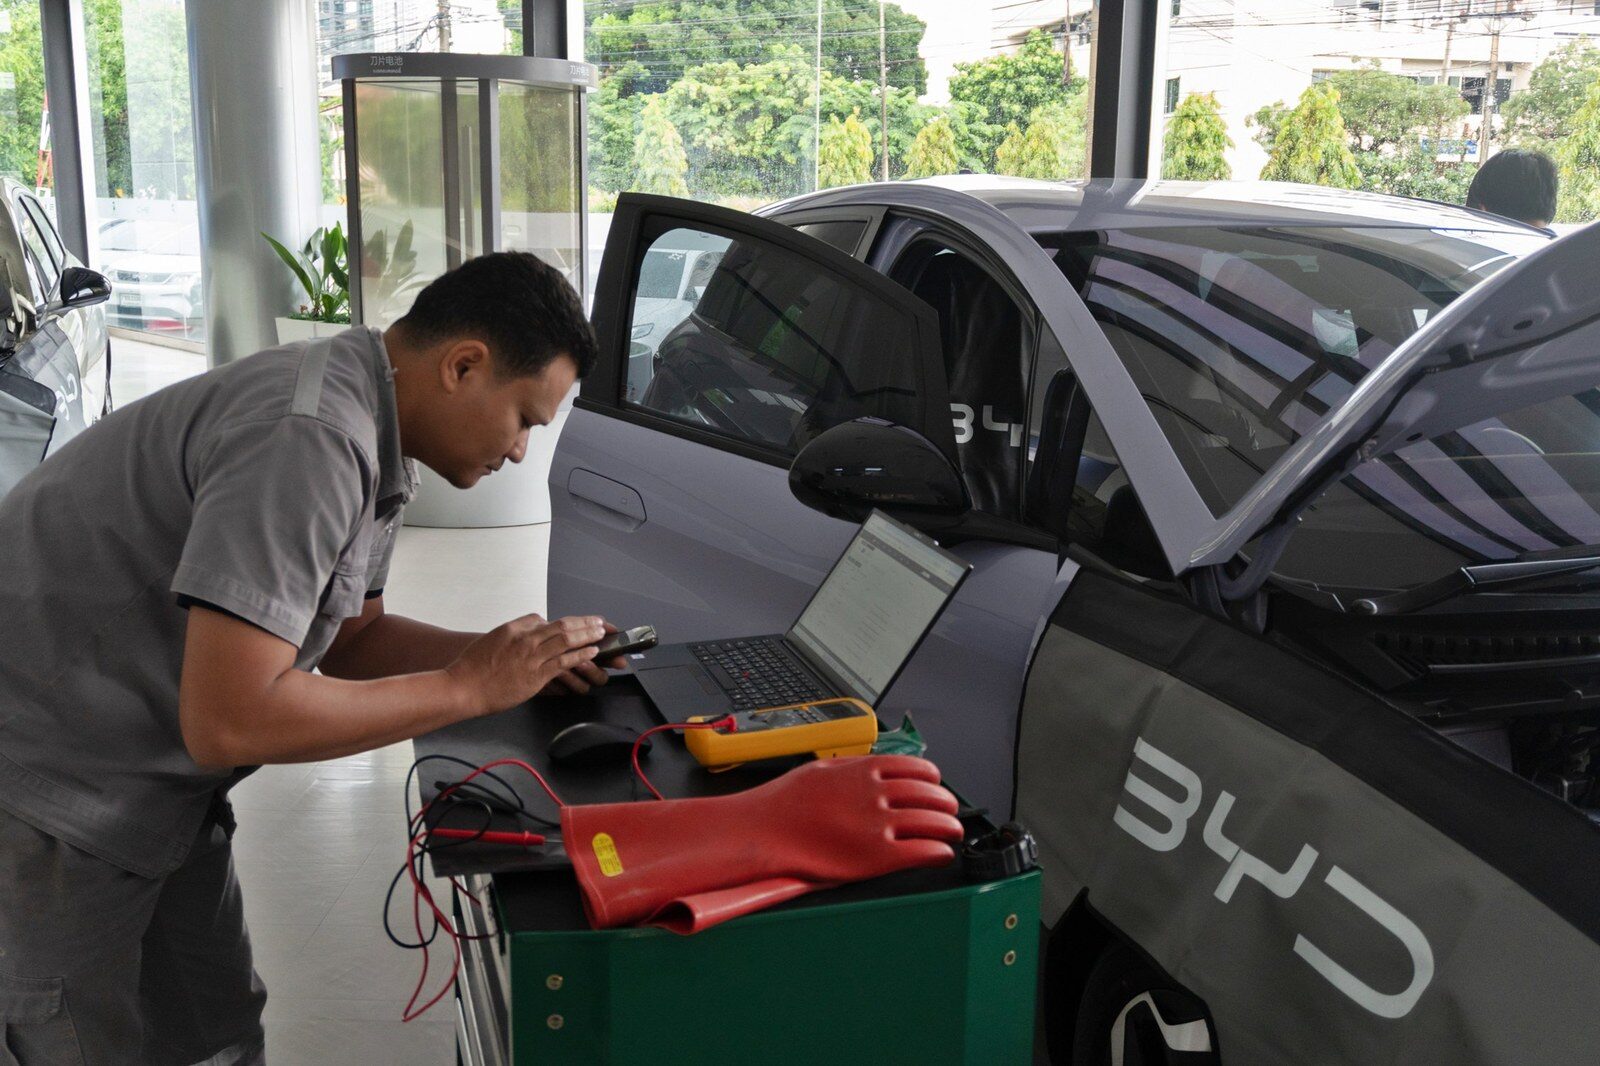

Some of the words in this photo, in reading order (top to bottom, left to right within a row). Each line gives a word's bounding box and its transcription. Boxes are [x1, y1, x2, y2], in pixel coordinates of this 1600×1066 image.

[370, 55, 404, 66] 刀片电池
[1113, 736, 1435, 1019] BYD
